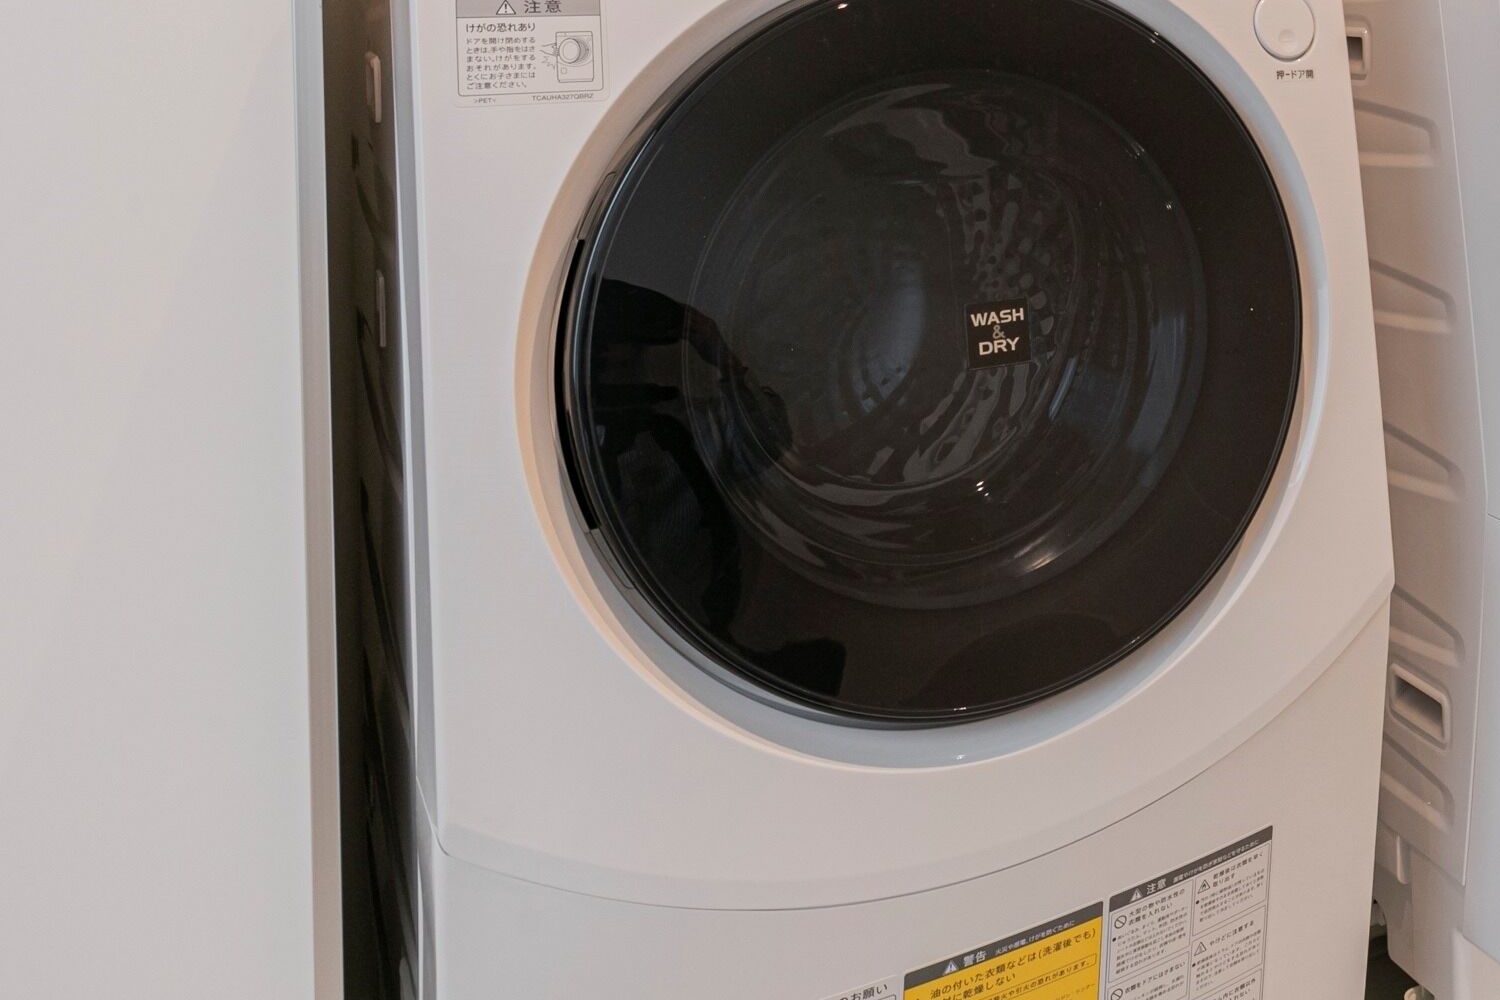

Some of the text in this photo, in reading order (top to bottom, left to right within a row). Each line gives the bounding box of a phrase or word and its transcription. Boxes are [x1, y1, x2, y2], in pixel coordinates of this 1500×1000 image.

[523, 0, 563, 15] 注意
[465, 22, 537, 34] けがの恐れあり
[465, 36, 536, 46] ドアを開け閉めする
[466, 62, 537, 73] おそれがあります。
[466, 71, 537, 81] とくにお子さまには
[466, 81, 527, 90] ご注意ください。
[970, 307, 1025, 328] WASH
[992, 324, 1006, 339] &
[978, 336, 1020, 356] DRY
[1145, 877, 1167, 895] 注意
[963, 949, 987, 967] 警告
